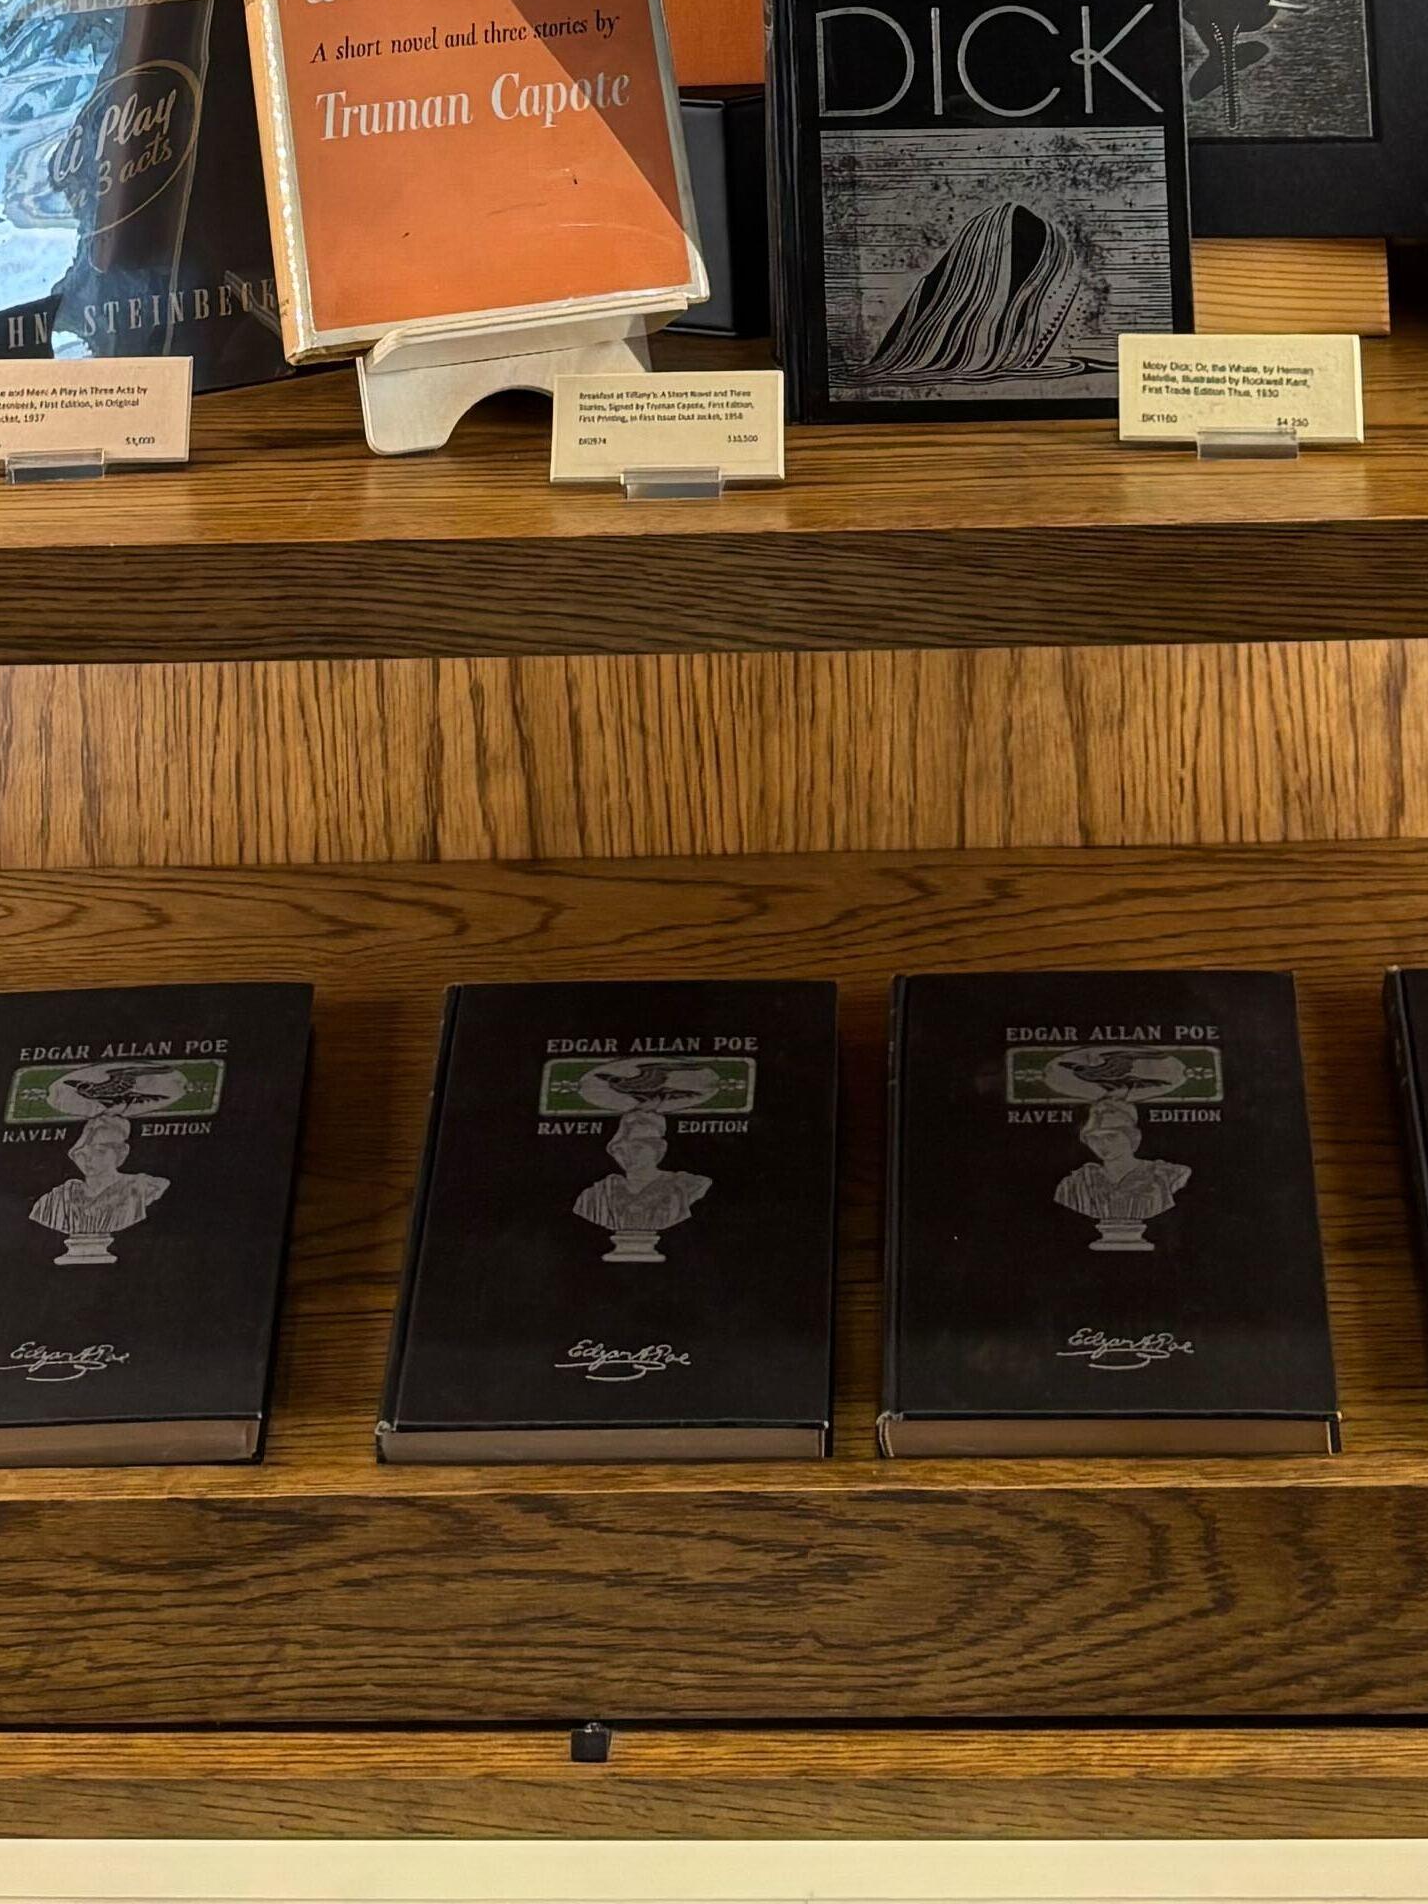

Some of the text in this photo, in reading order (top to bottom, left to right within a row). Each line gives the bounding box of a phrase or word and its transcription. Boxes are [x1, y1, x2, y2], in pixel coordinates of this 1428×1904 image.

[310, 10, 620, 64] A short novel and three stories by
[816, 2, 1163, 118] DICK
[96, 90, 176, 156] Play
[315, 66, 630, 141] Truman Capote
[120, 132, 172, 181] acts
[84, 278, 276, 337] STEINBECK
